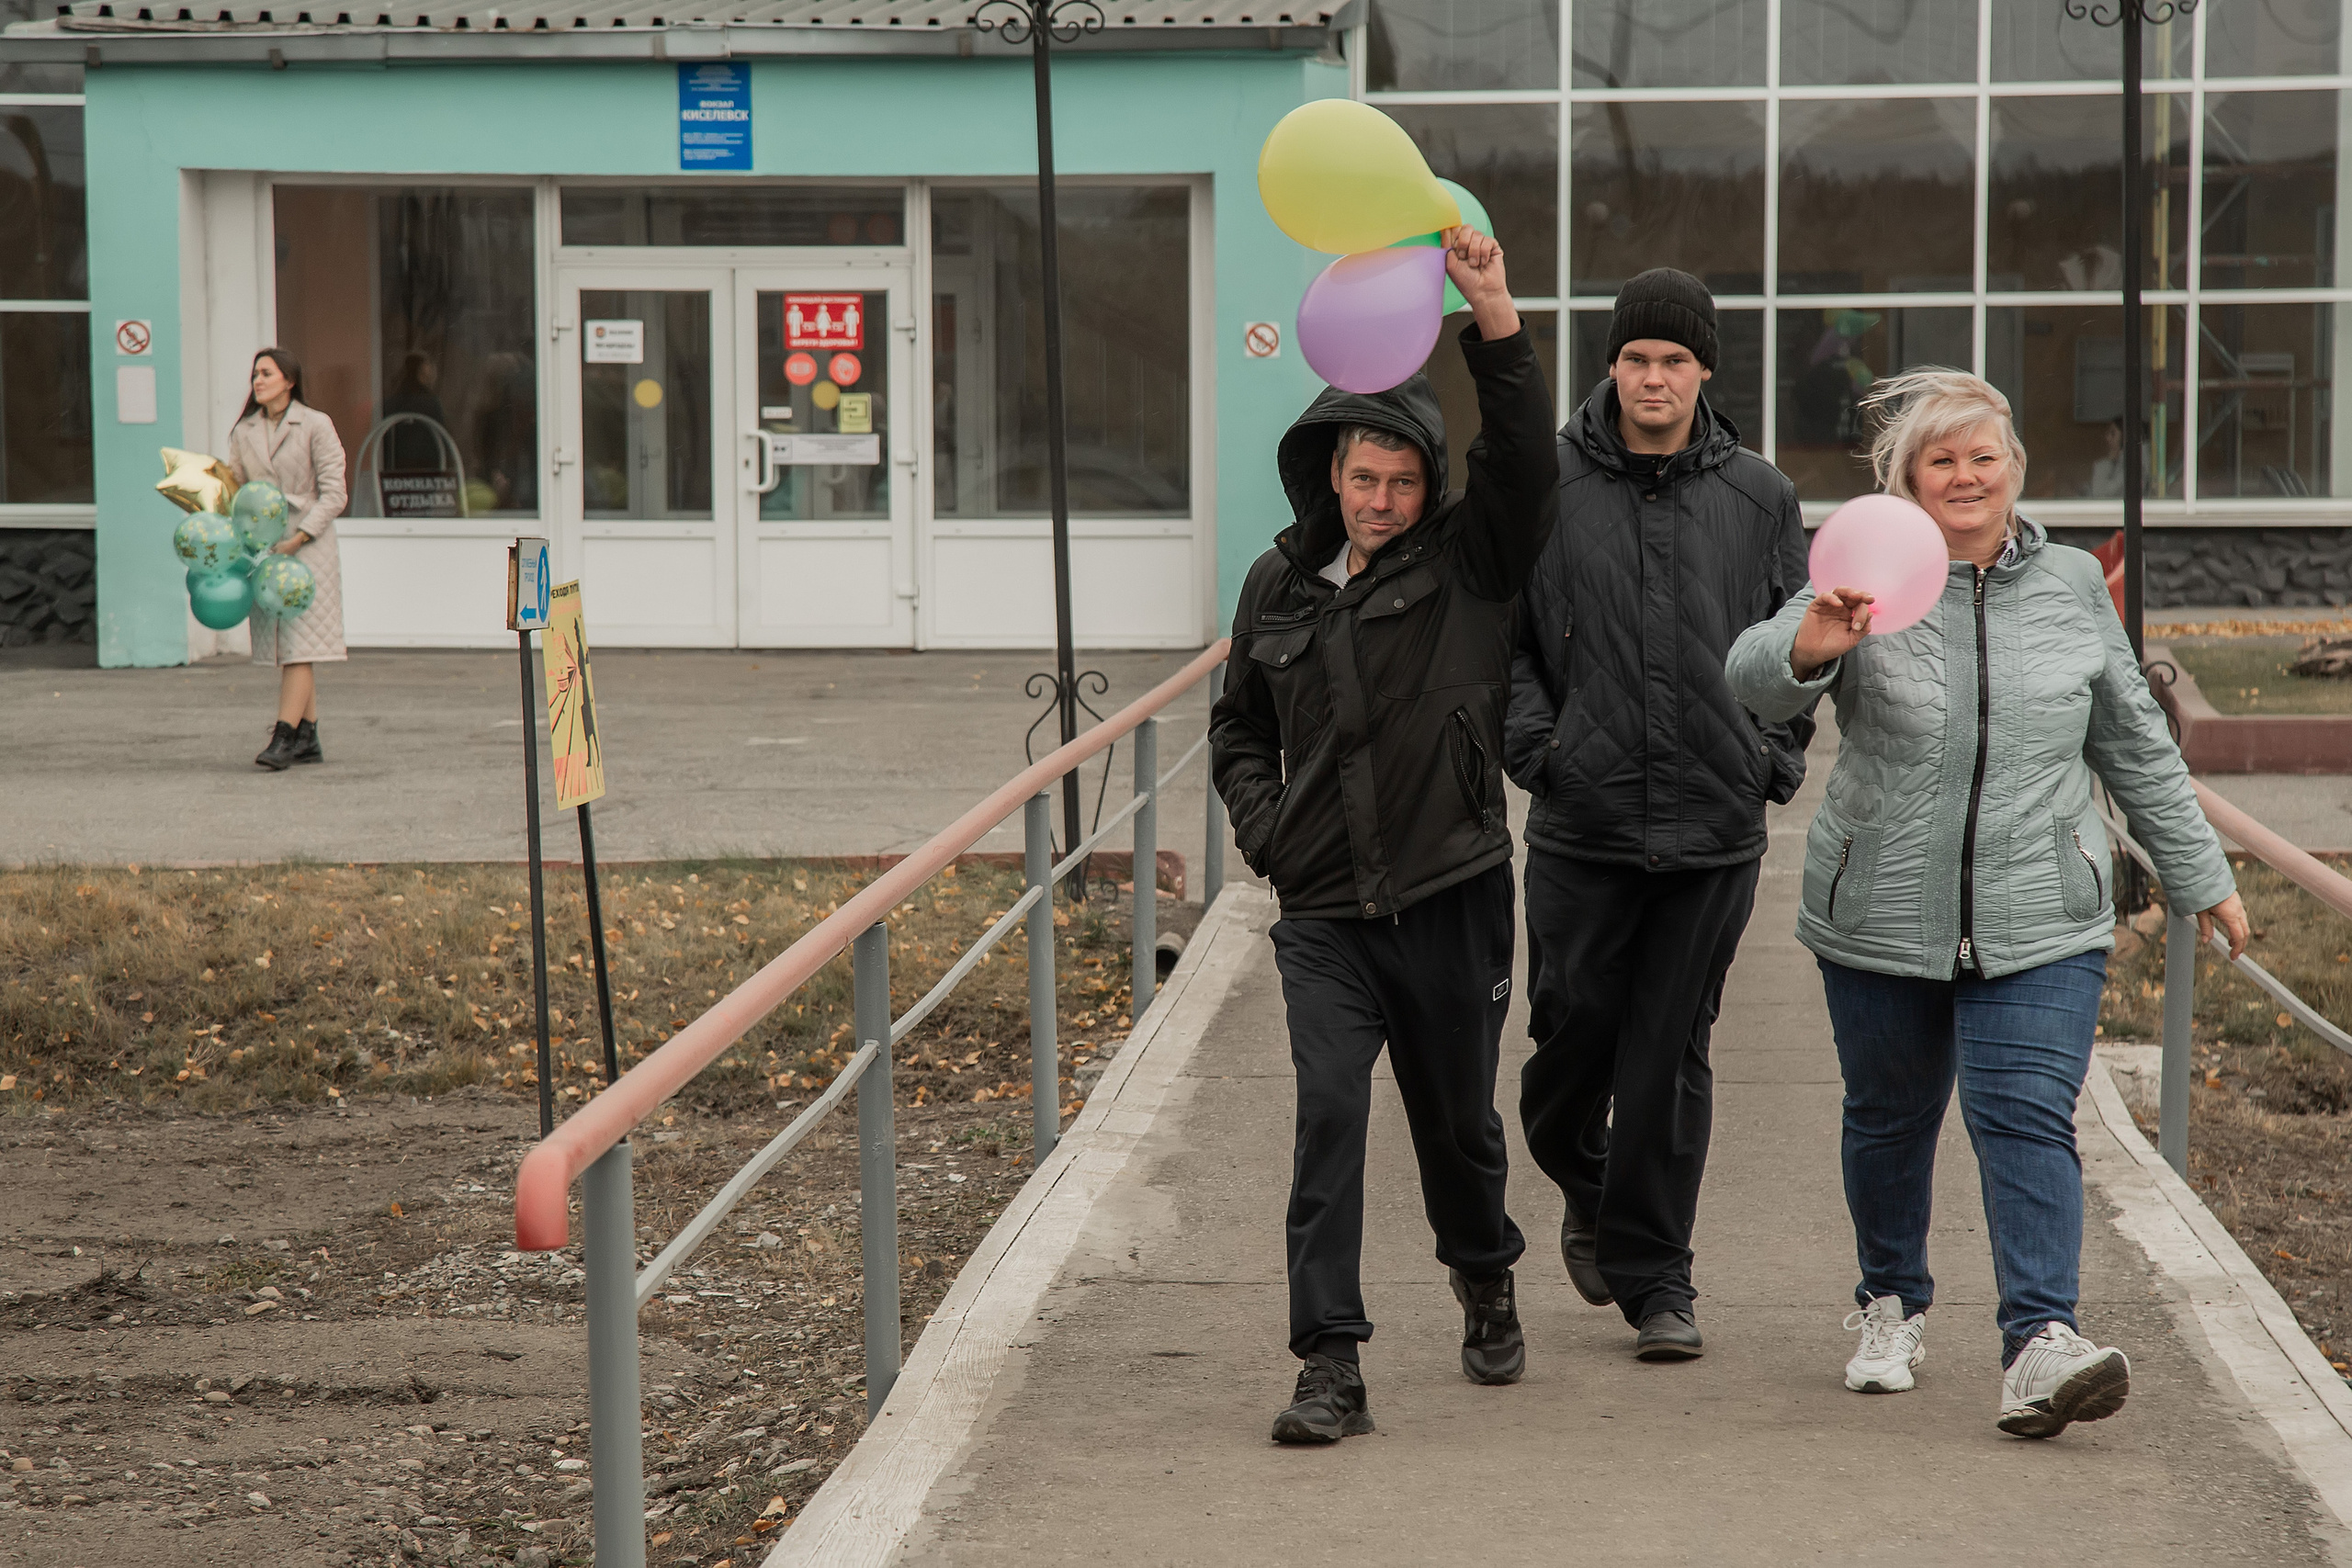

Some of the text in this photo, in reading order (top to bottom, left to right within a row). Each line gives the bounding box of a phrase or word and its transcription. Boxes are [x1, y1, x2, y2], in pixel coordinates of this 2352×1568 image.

[700, 100, 734, 108] ВОКЗАЛ
[683, 109, 749, 121] КИСЕЛЕВСК
[383, 478, 457, 491] КОМНАТЫ
[389, 493, 456, 508] ОТДЫХА
